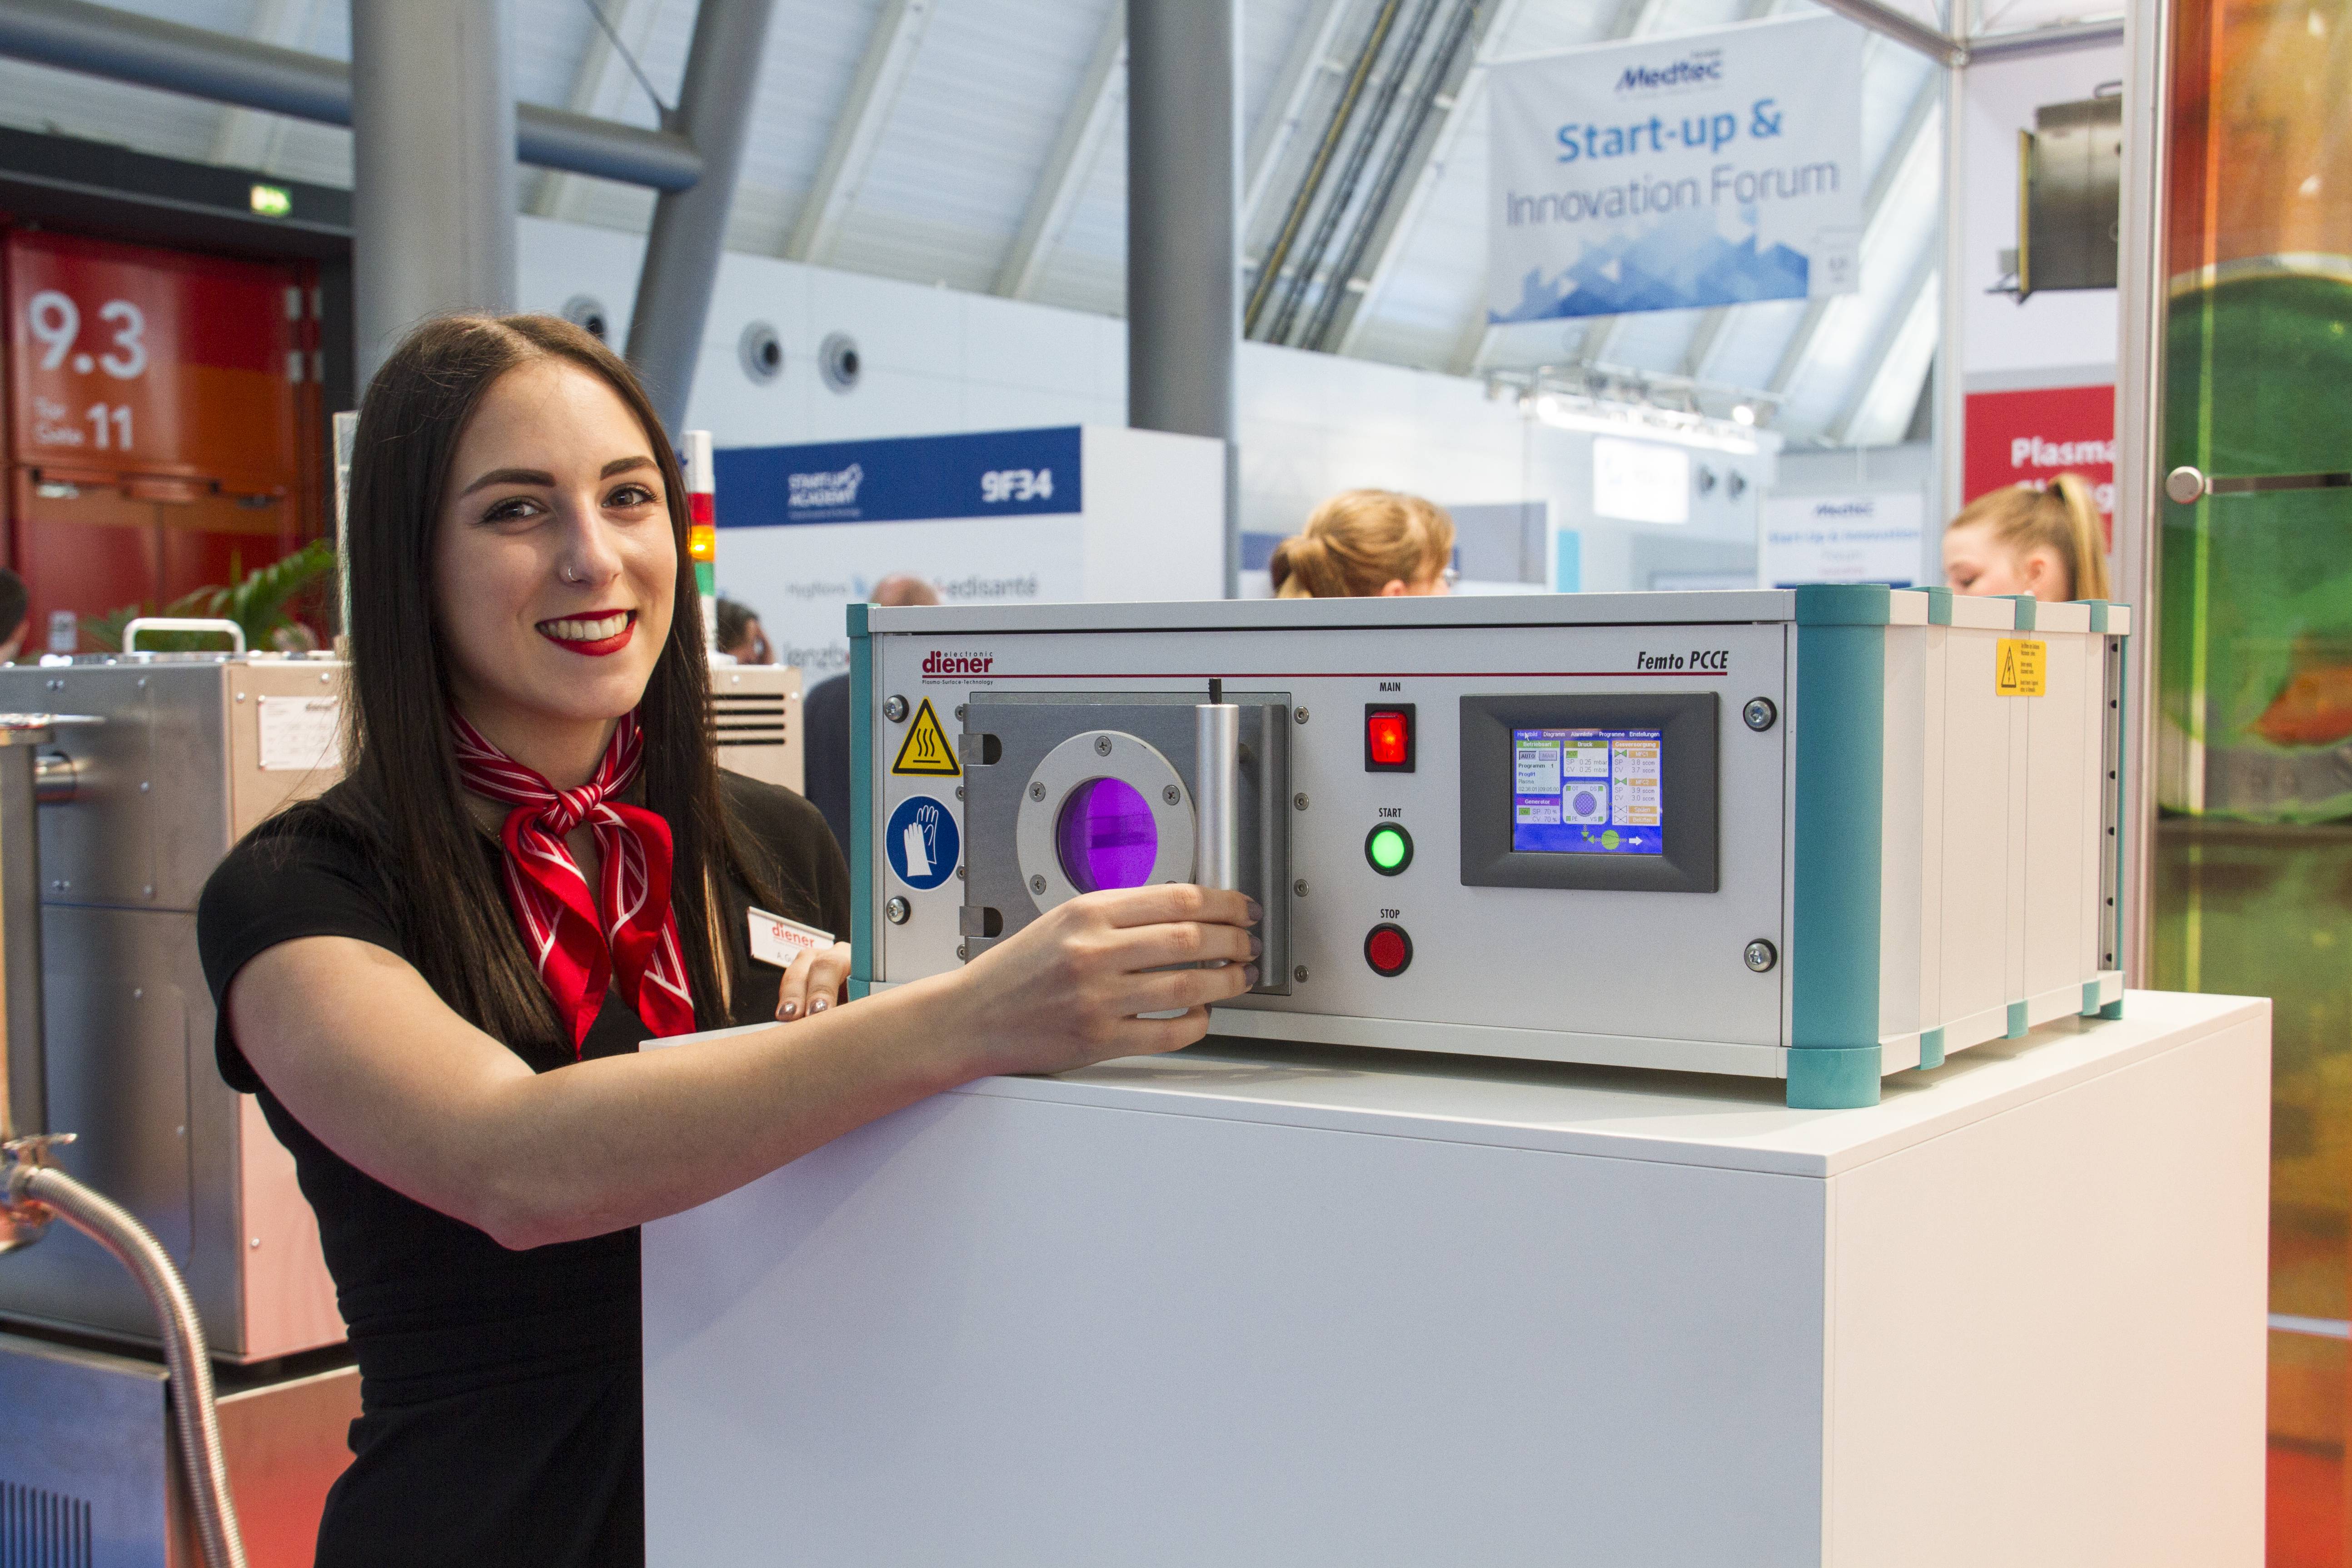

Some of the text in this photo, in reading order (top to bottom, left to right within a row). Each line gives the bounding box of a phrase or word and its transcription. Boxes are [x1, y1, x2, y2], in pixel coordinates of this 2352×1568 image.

[1615, 60, 1723, 92] Medtec
[1556, 97, 1783, 164] Start-up &
[1506, 160, 1840, 227] Innovation Forum
[28, 289, 146, 380] 9.3
[86, 402, 134, 451] 11
[981, 468, 1053, 502] 9F34
[922, 651, 993, 673] diener
[1637, 651, 1729, 669] Femto PCCE
[1380, 682, 1400, 692] MAIN
[1379, 808, 1401, 817] START
[1380, 909, 1400, 918] STOP
[772, 921, 815, 947] diener
